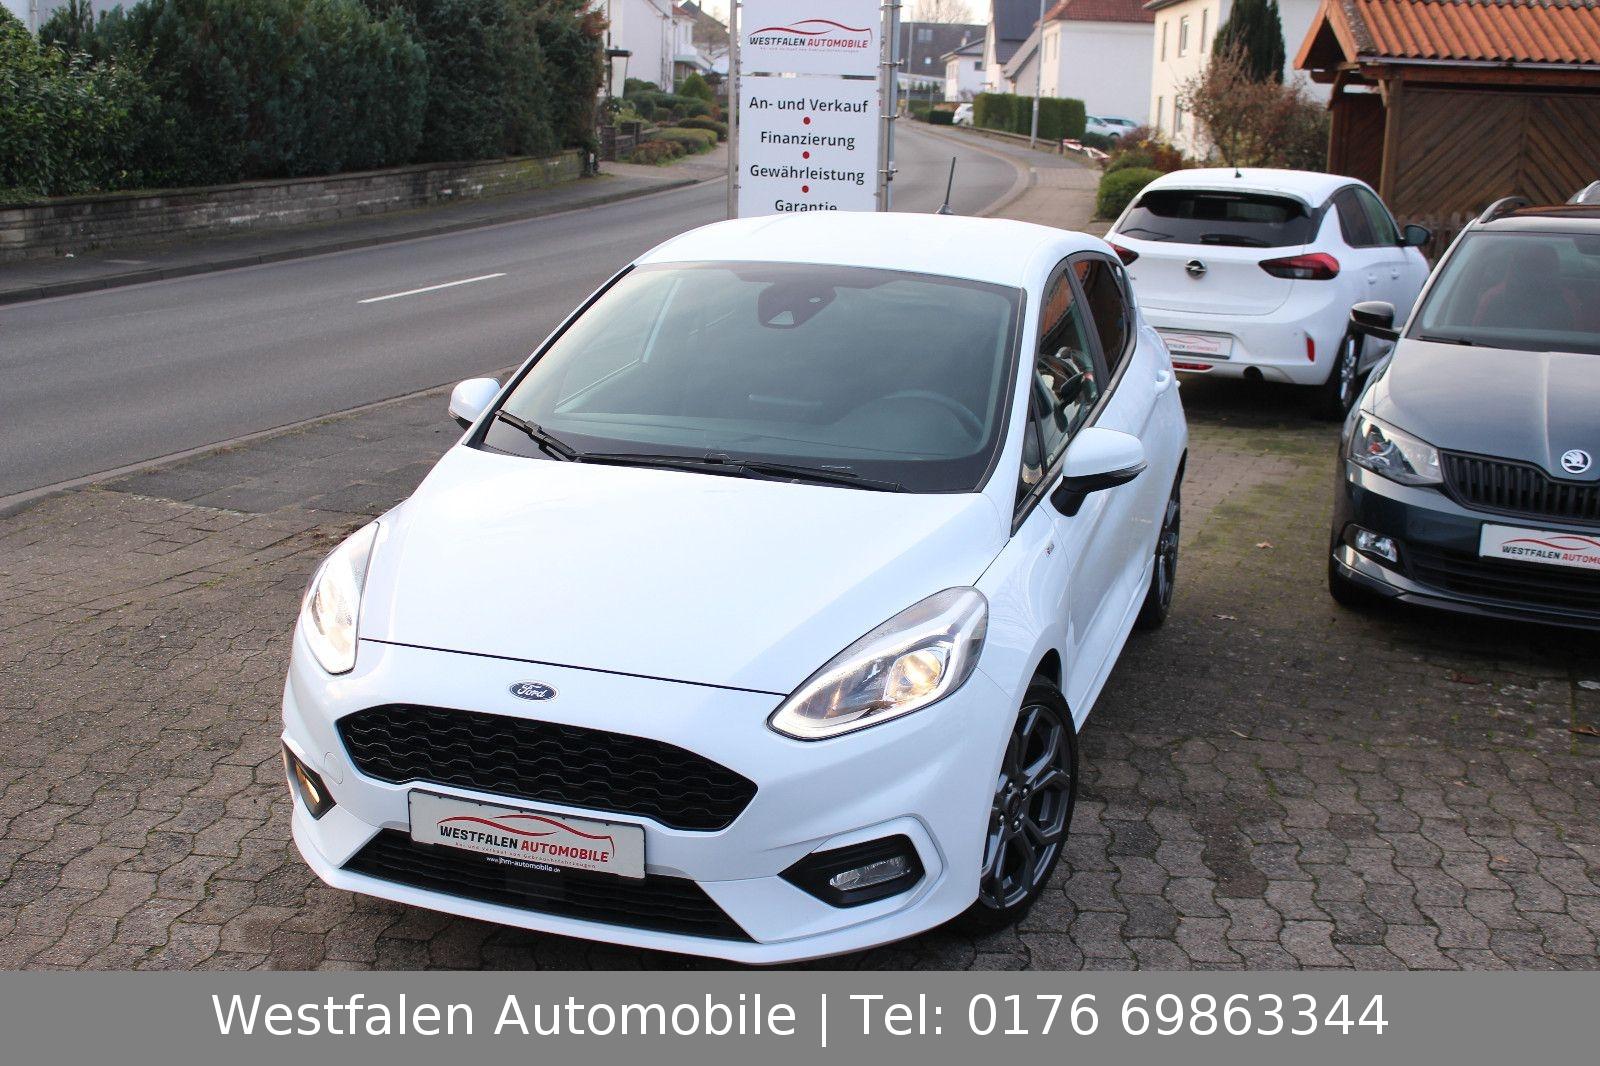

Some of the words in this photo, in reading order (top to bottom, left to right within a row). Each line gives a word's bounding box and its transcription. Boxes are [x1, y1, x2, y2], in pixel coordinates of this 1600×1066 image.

[749, 36, 806, 47] WESTFALEN
[807, 38, 868, 49] AUTOMOBILE
[749, 96, 773, 109] An-
[777, 98, 805, 111] und
[809, 99, 868, 113] Verkauf
[760, 131, 855, 151] Finanzierung
[750, 164, 865, 186] Gewährleistung
[1502, 545, 1560, 560] WESTFALEN
[517, 684, 548, 698] Ford
[440, 825, 519, 850] WESTFALEN
[520, 839, 610, 863] AUTOMOBILE
